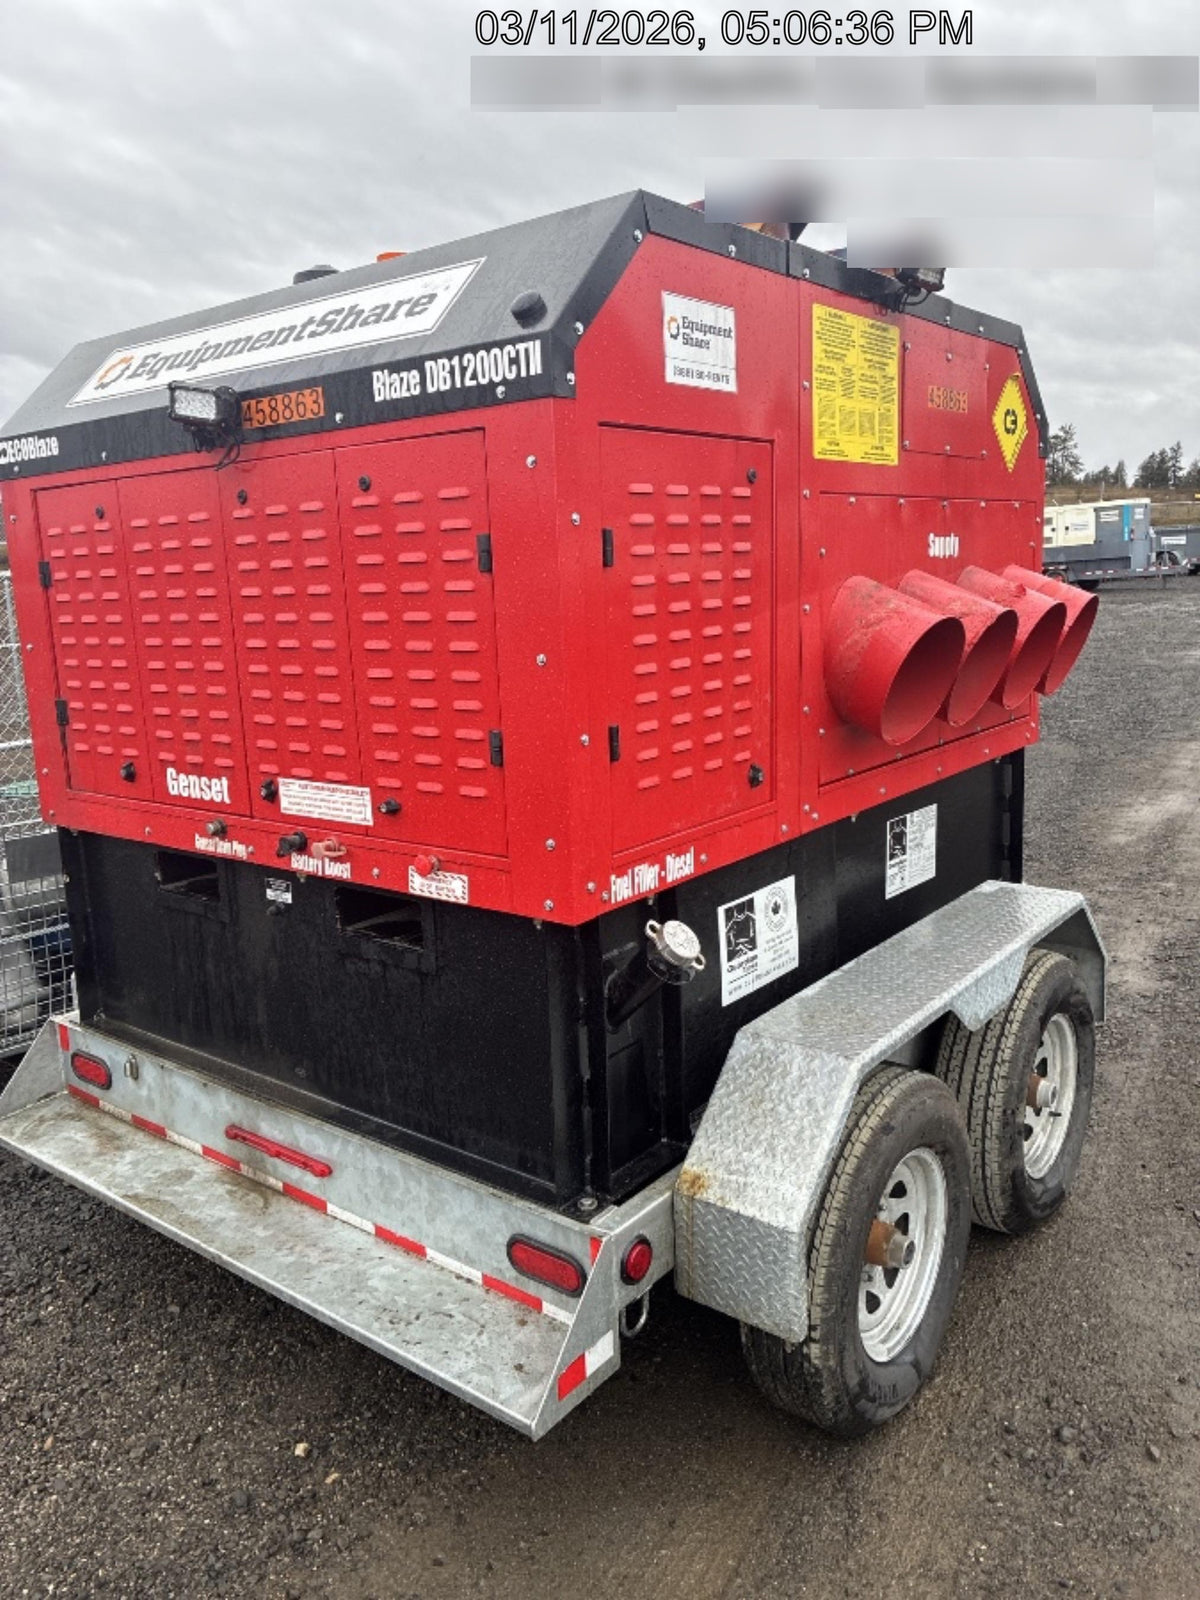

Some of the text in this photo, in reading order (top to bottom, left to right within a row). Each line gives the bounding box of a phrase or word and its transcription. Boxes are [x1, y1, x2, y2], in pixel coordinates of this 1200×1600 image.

[130, 292, 438, 379] EquipmentShare
[682, 316, 733, 338] Equipment
[682, 332, 710, 349] Share
[372, 368, 421, 403] Blaze
[243, 389, 321, 427] 458863
[928, 532, 959, 559] Supply
[166, 767, 231, 804] Genset
[291, 852, 322, 876] Battery
[610, 867, 633, 905] Fuel
[665, 845, 695, 883] Diesel
